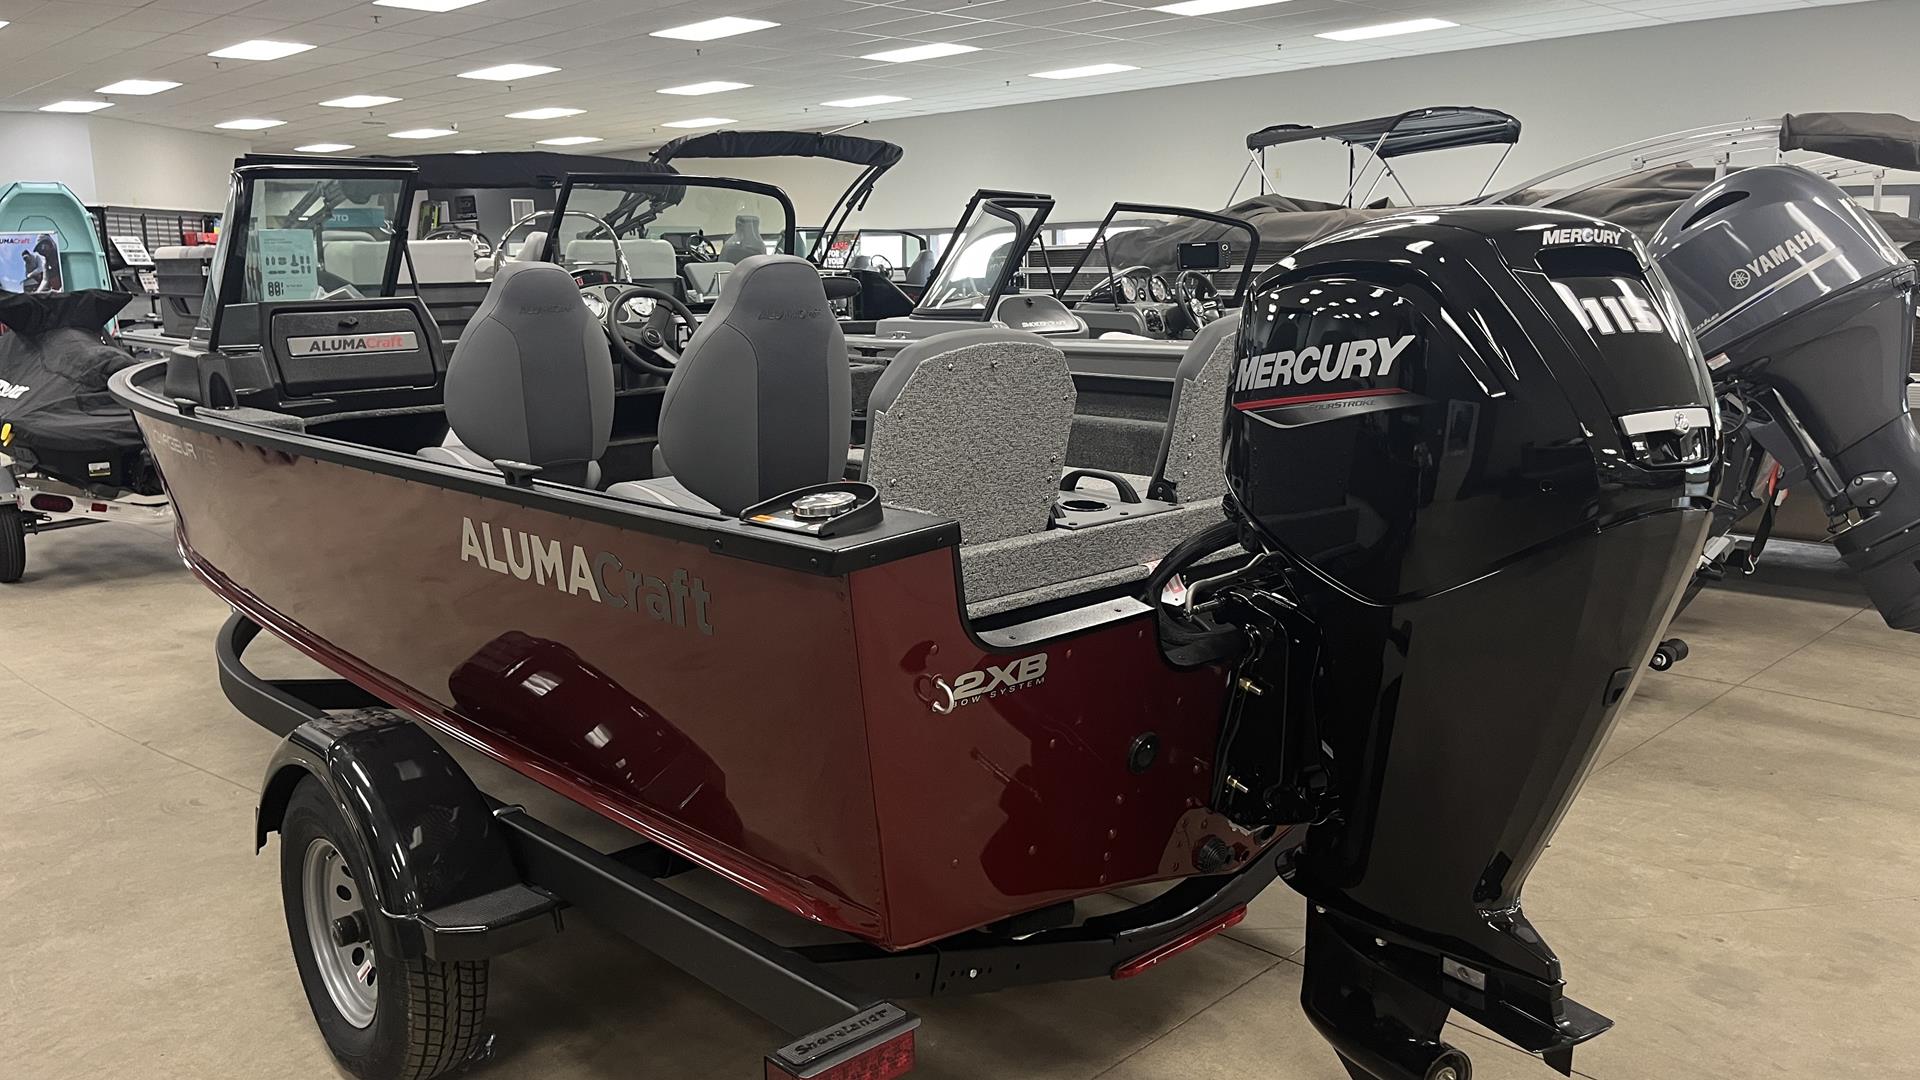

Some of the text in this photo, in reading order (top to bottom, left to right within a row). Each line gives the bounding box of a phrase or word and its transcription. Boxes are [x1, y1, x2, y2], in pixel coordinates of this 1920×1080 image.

[1542, 228, 1621, 245] MERCURY
[1746, 229, 1822, 278] YAMAHA
[1580, 297, 1663, 334] 115
[309, 336, 404, 353] ALUMACraft
[1234, 334, 1416, 393] MERCURY
[461, 516, 714, 636] ALUMACraft
[953, 652, 1049, 700] 2XB
[990, 677, 1045, 698] SYSTEM
